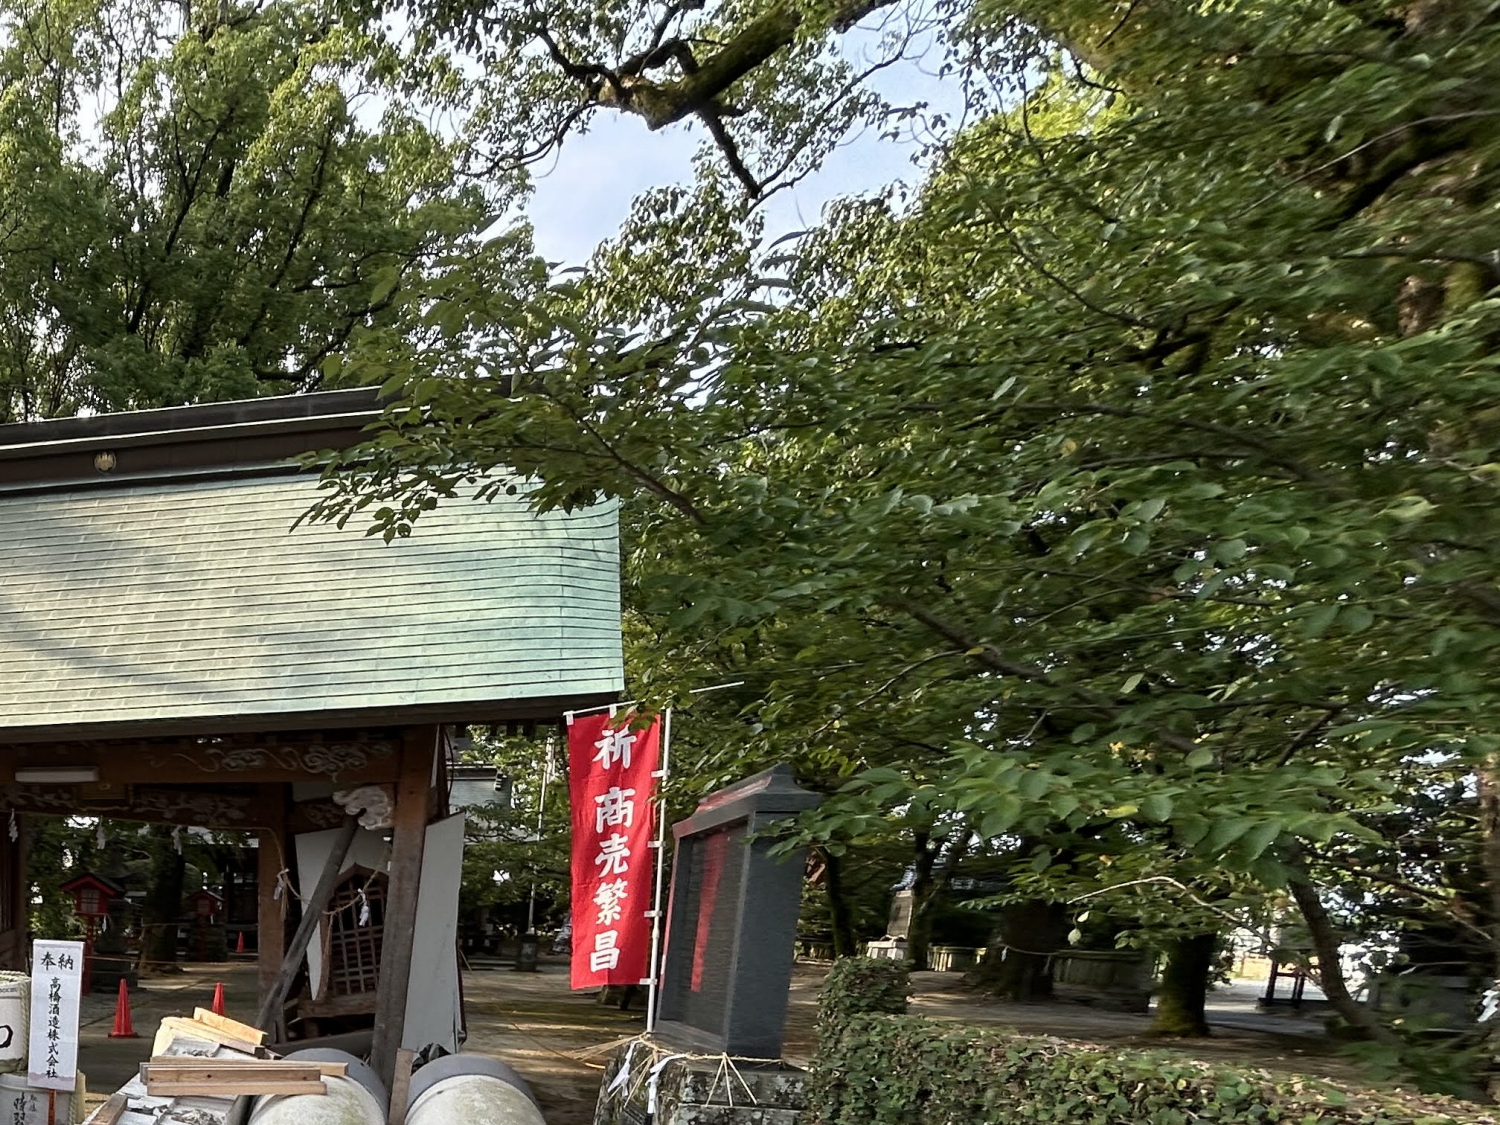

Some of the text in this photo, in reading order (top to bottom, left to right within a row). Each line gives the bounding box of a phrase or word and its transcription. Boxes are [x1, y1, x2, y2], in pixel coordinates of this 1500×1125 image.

[589, 724, 638, 974] 祈 商売繁昌
[41, 951, 74, 971] 奉納
[45, 977, 62, 1079] 高橋酒造株式会社
